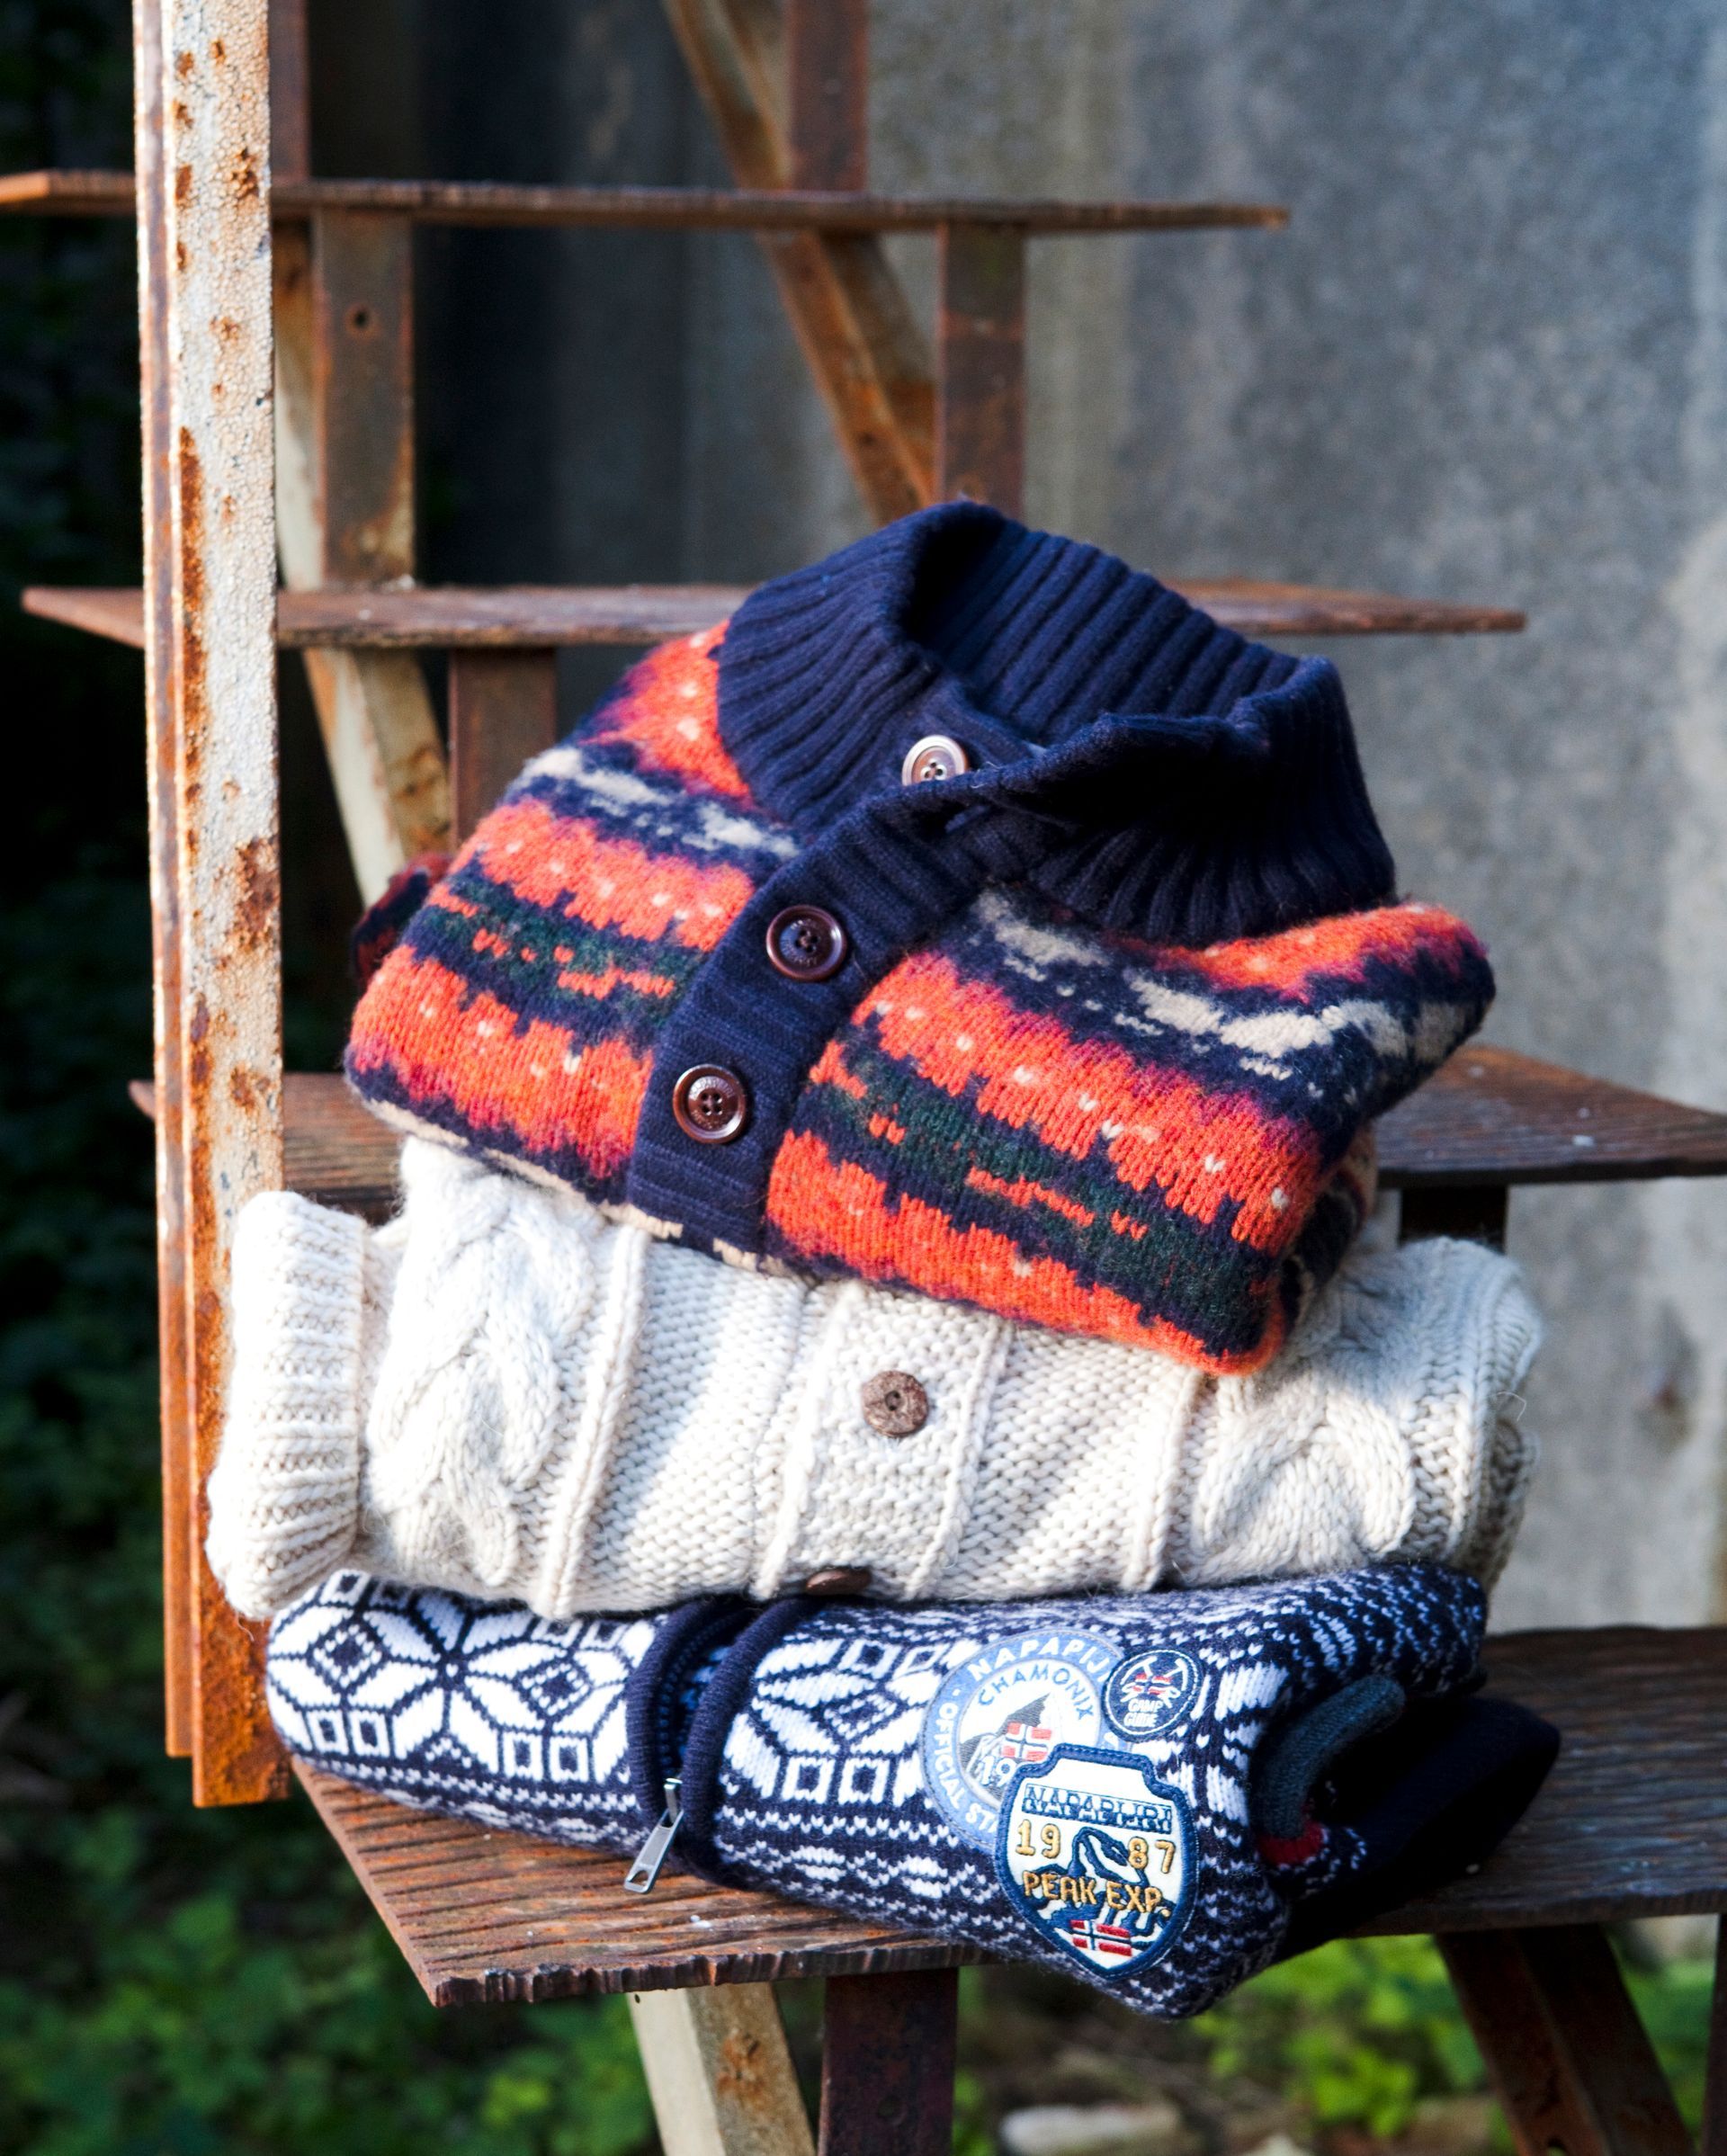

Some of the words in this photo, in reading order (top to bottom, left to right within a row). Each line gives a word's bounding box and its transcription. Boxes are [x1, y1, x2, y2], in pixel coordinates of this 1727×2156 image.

[978, 1664, 1094, 1721] CHAMONIX
[934, 1702, 965, 1810] OFFICIAL
[1015, 1819, 1060, 1859] 19
[1127, 1836, 1176, 1874] 87
[1022, 1870, 1097, 1905] PEAK
